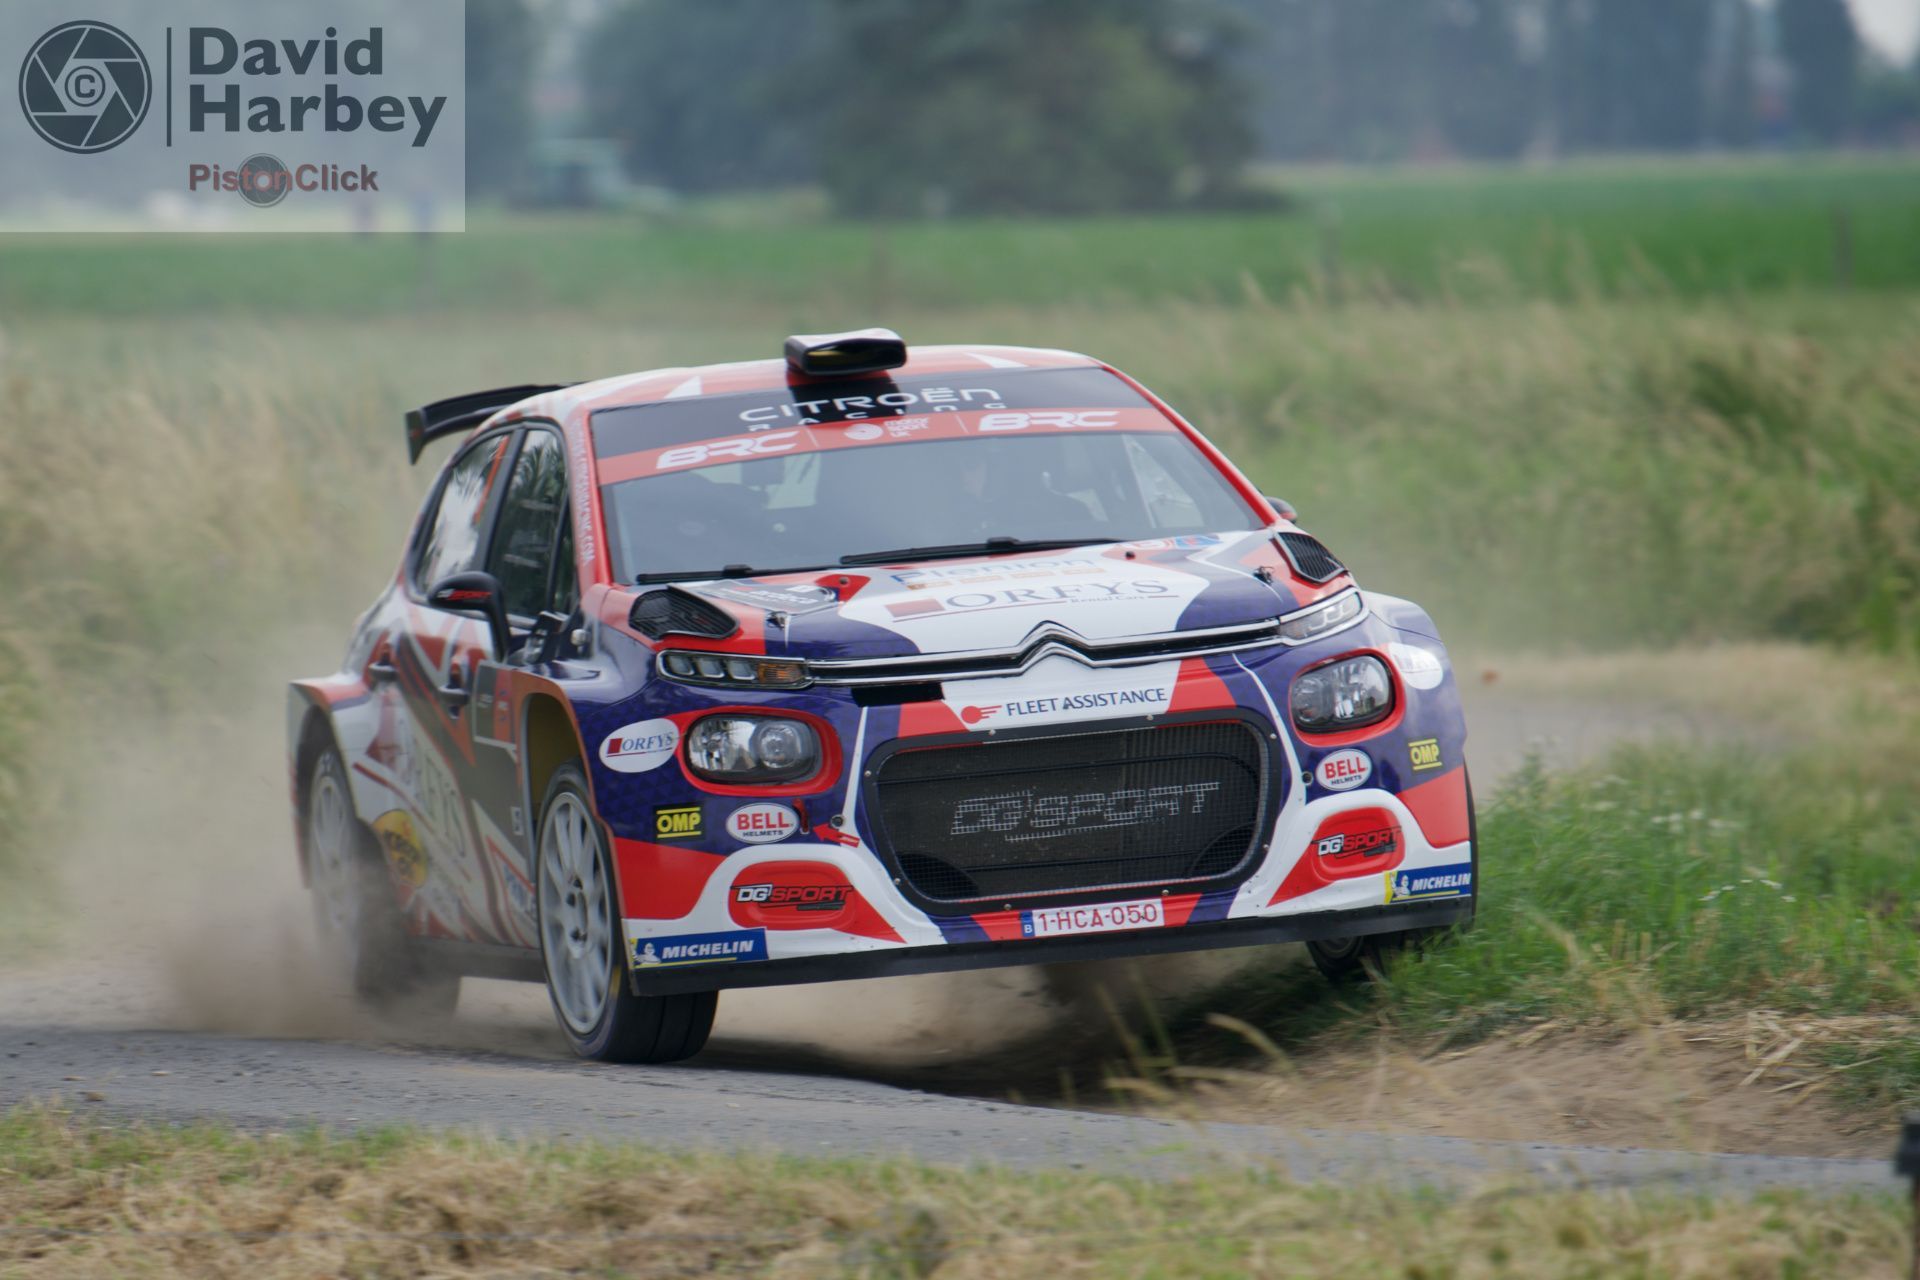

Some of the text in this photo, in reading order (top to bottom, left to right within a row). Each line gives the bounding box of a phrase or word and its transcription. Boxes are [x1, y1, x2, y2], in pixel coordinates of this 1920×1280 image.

[978, 410, 1120, 431] BRC
[656, 430, 799, 469] BRC
[946, 578, 1169, 608] ORFYS
[1006, 688, 1168, 717] FLEET ASSISTANCE
[622, 732, 675, 751] ORFYS
[1410, 744, 1440, 764] OMP
[1325, 757, 1367, 778] BELL
[1331, 775, 1362, 785] HELMETS
[657, 812, 701, 832] OMP
[737, 812, 789, 830] BELL
[1411, 873, 1471, 891] MICHELIN
[1039, 904, 1157, 931] 1-HCA-050
[662, 940, 754, 959] MICHELIN
